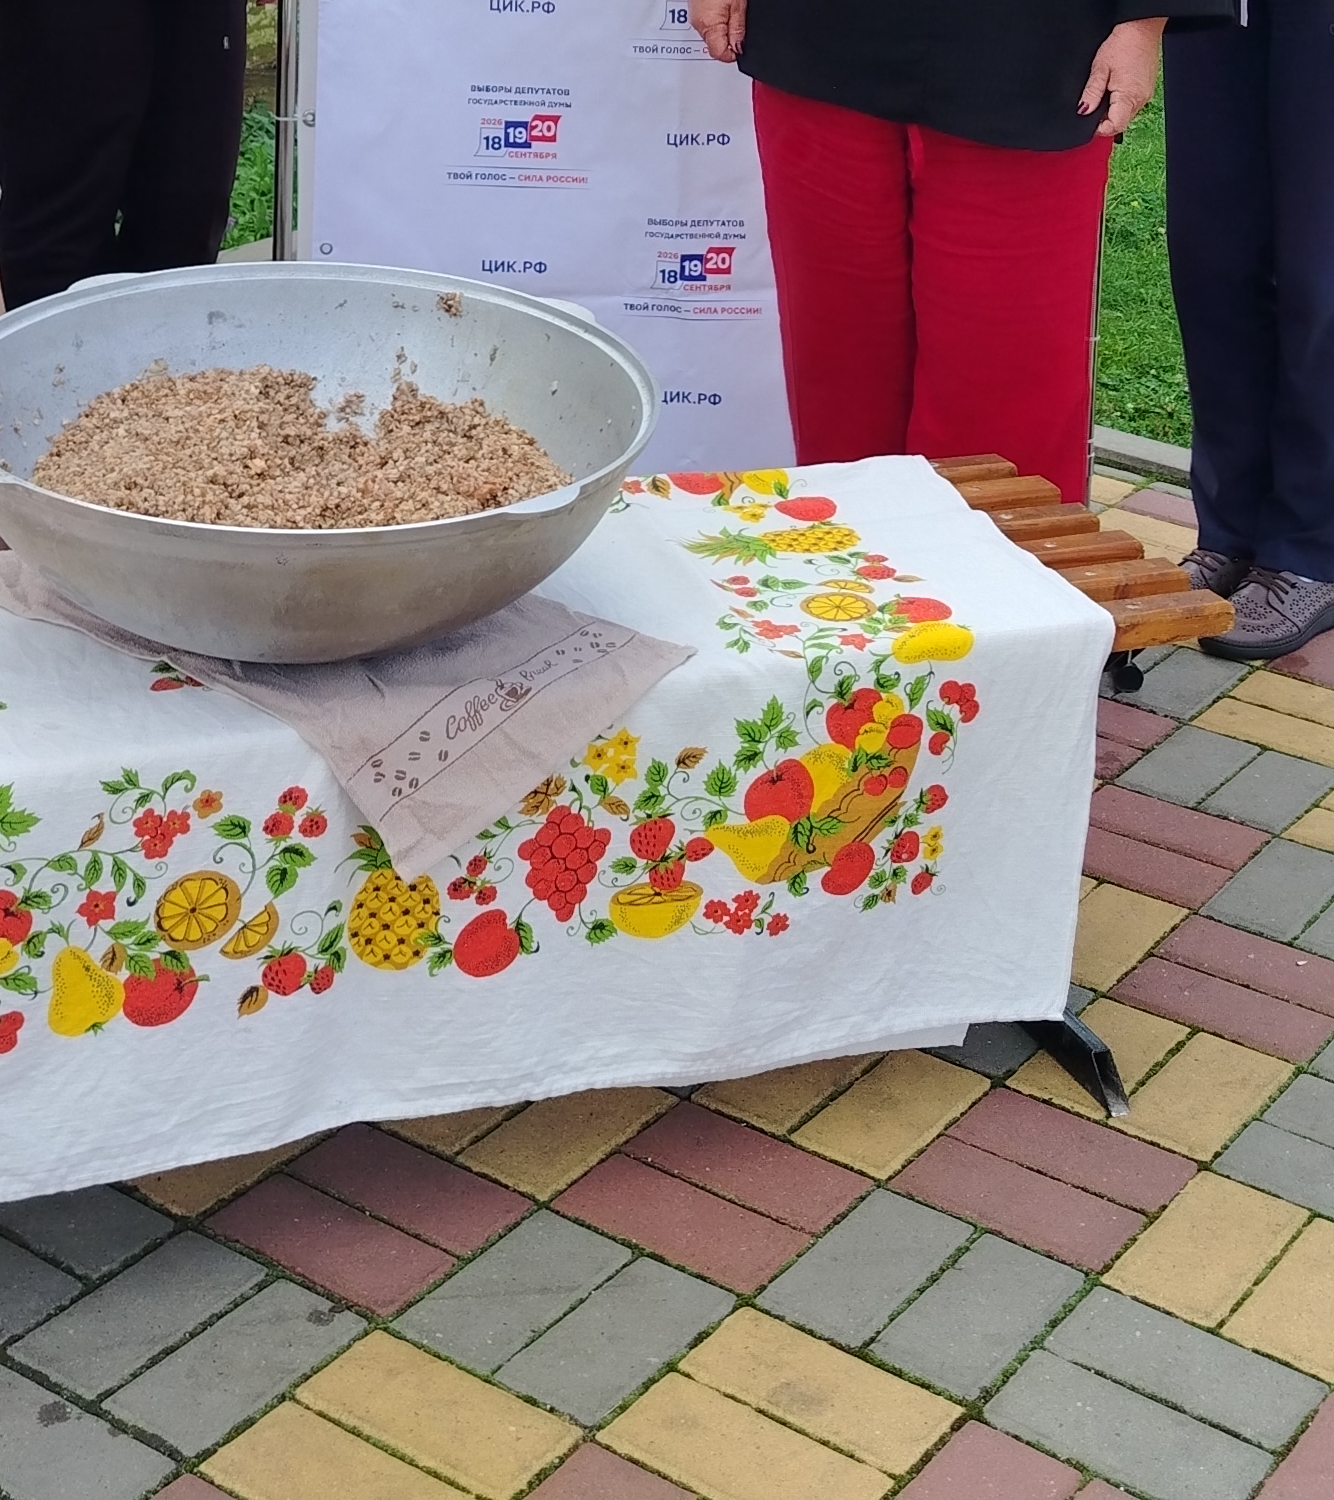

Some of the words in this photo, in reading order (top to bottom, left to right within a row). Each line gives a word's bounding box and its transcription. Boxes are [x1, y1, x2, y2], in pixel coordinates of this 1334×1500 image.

[490, 0, 555, 13] ЦИК.РФ
[669, 9, 688, 23] 18
[633, 44, 658, 54] ТВОЙ
[661, 46, 692, 54] ГОЛОС
[470, 85, 512, 93] ВЫБОРЫ
[514, 86, 570, 96] ДЕПУТАТОВ
[483, 136, 502, 151] 18
[507, 127, 526, 143] 19
[530, 120, 556, 137] 20
[667, 133, 730, 147] ЦИК.РФ
[508, 151, 557, 159] СЕНТЯБРЯ
[447, 171, 472, 180] ТВОЙ
[475, 173, 507, 181] ГОЛОС
[518, 174, 543, 182] СИЛА
[647, 218, 687, 227] ВЫБОРЫ
[690, 219, 744, 228] ДЕПУТАТОВ
[657, 251, 679, 259] 2026
[481, 259, 548, 274] ЦИК.РФ
[659, 269, 678, 284] 18
[682, 260, 701, 276] 19
[705, 253, 730, 268] 20
[623, 303, 649, 311] ТВОЙ
[651, 304, 682, 313] ГОЛОС
[446, 693, 498, 740] Coffee
